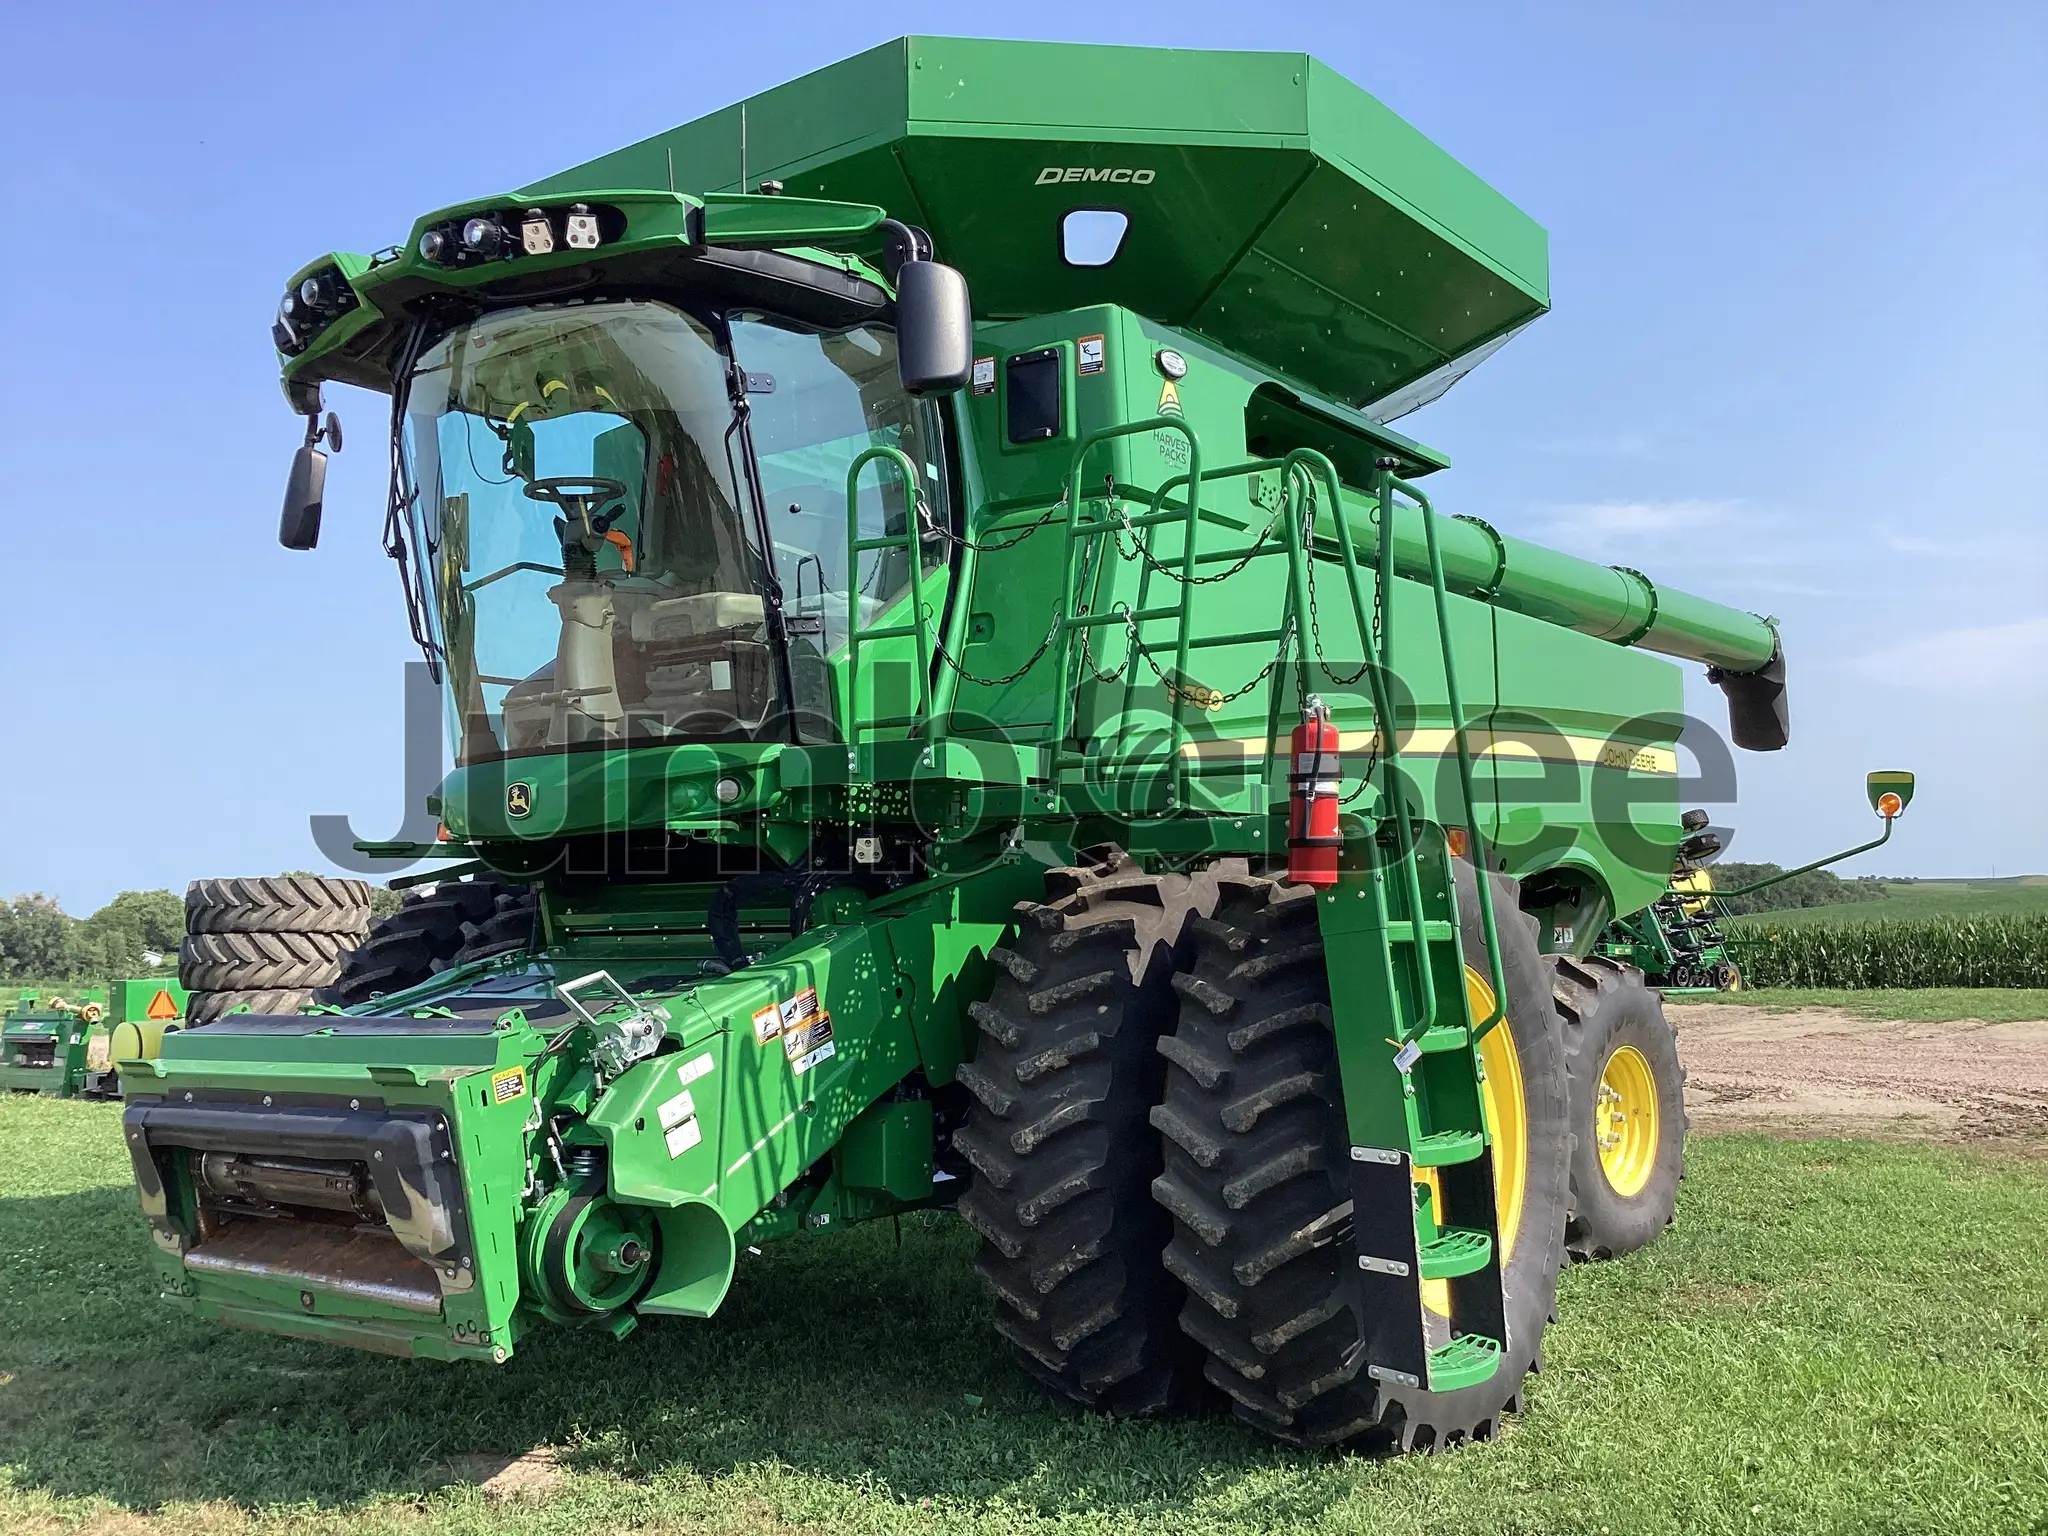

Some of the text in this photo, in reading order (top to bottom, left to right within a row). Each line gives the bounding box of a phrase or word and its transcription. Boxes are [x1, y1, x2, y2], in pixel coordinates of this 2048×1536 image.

[1034, 167, 1156, 185] DEMCO
[1153, 430, 1190, 453] HARVEST
[1160, 445, 1187, 464] PACKS
[1603, 745, 1657, 769] JOHN DEERE
